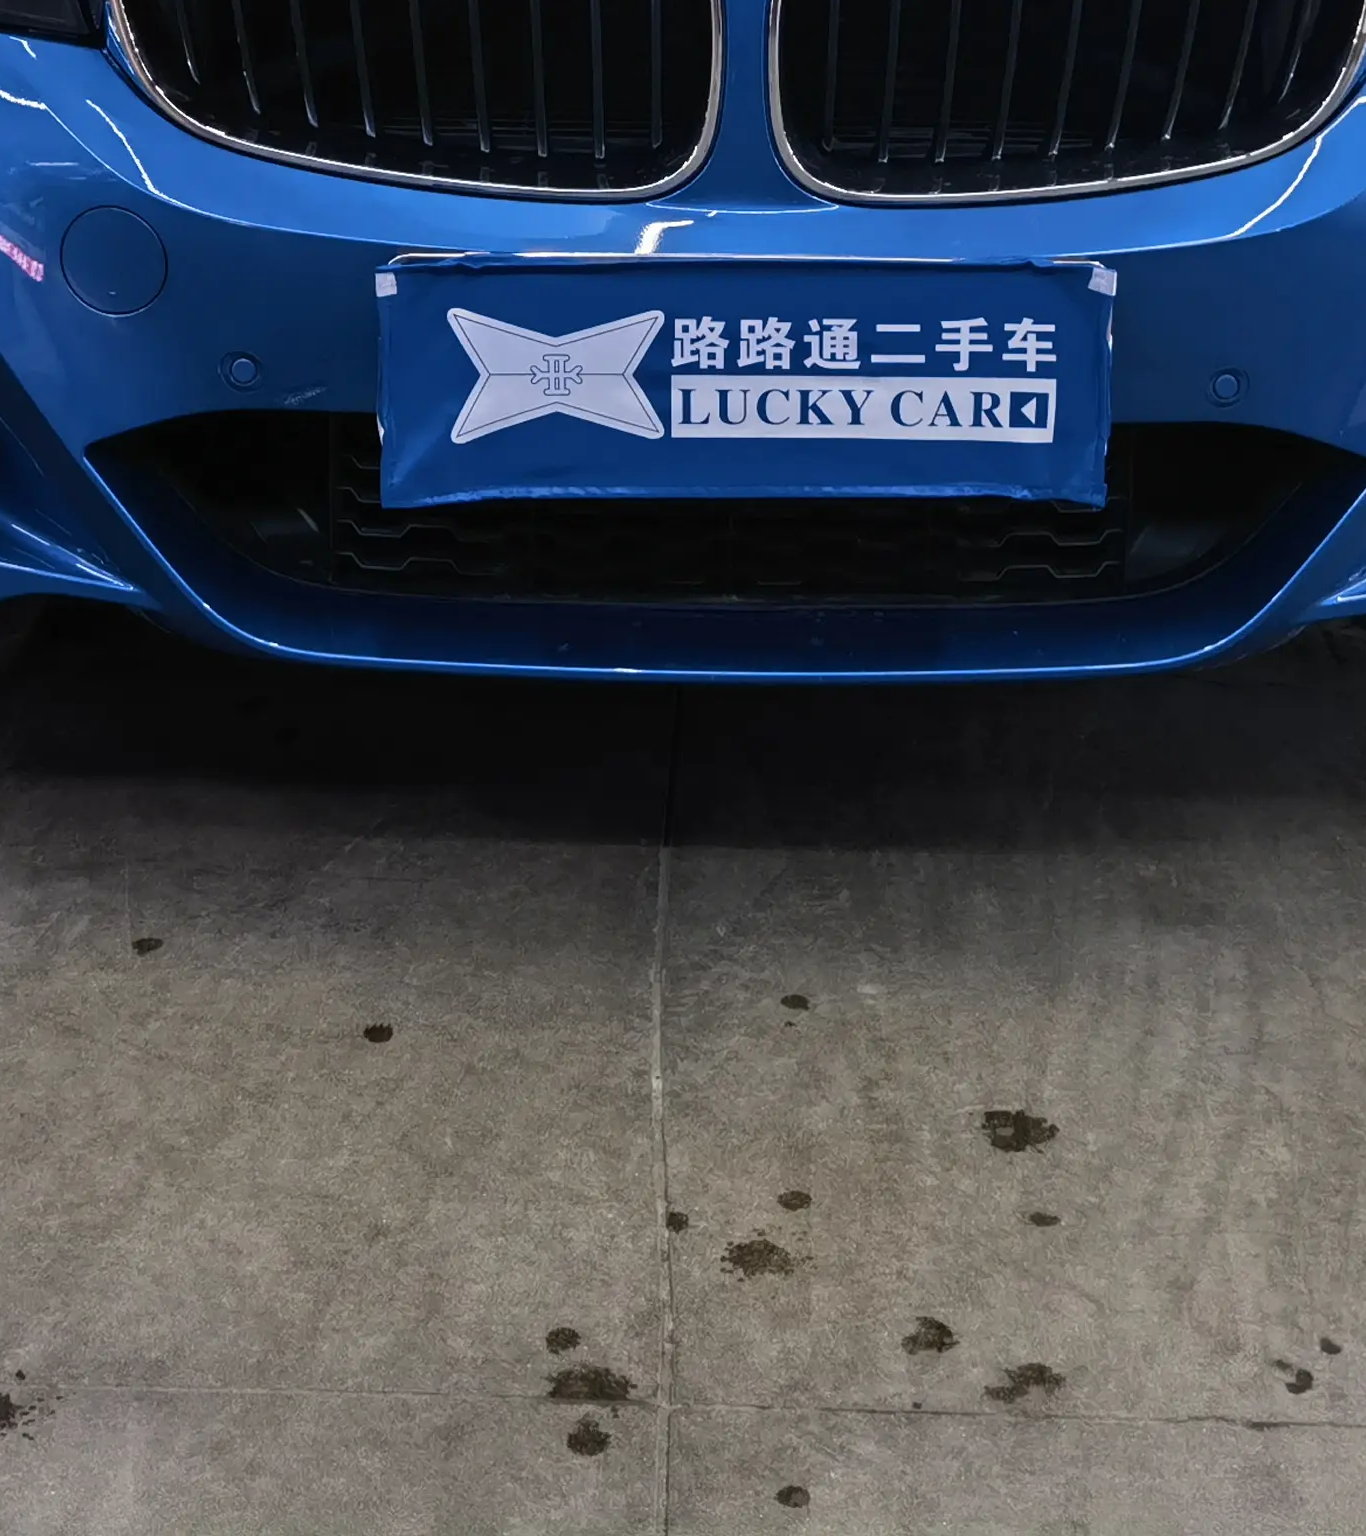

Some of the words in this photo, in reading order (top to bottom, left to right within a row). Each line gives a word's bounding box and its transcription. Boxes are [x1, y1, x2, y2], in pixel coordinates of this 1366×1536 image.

[671, 316, 1057, 373] 路路通二手车
[678, 388, 875, 427] LUCKY
[890, 390, 1003, 428] CAR
